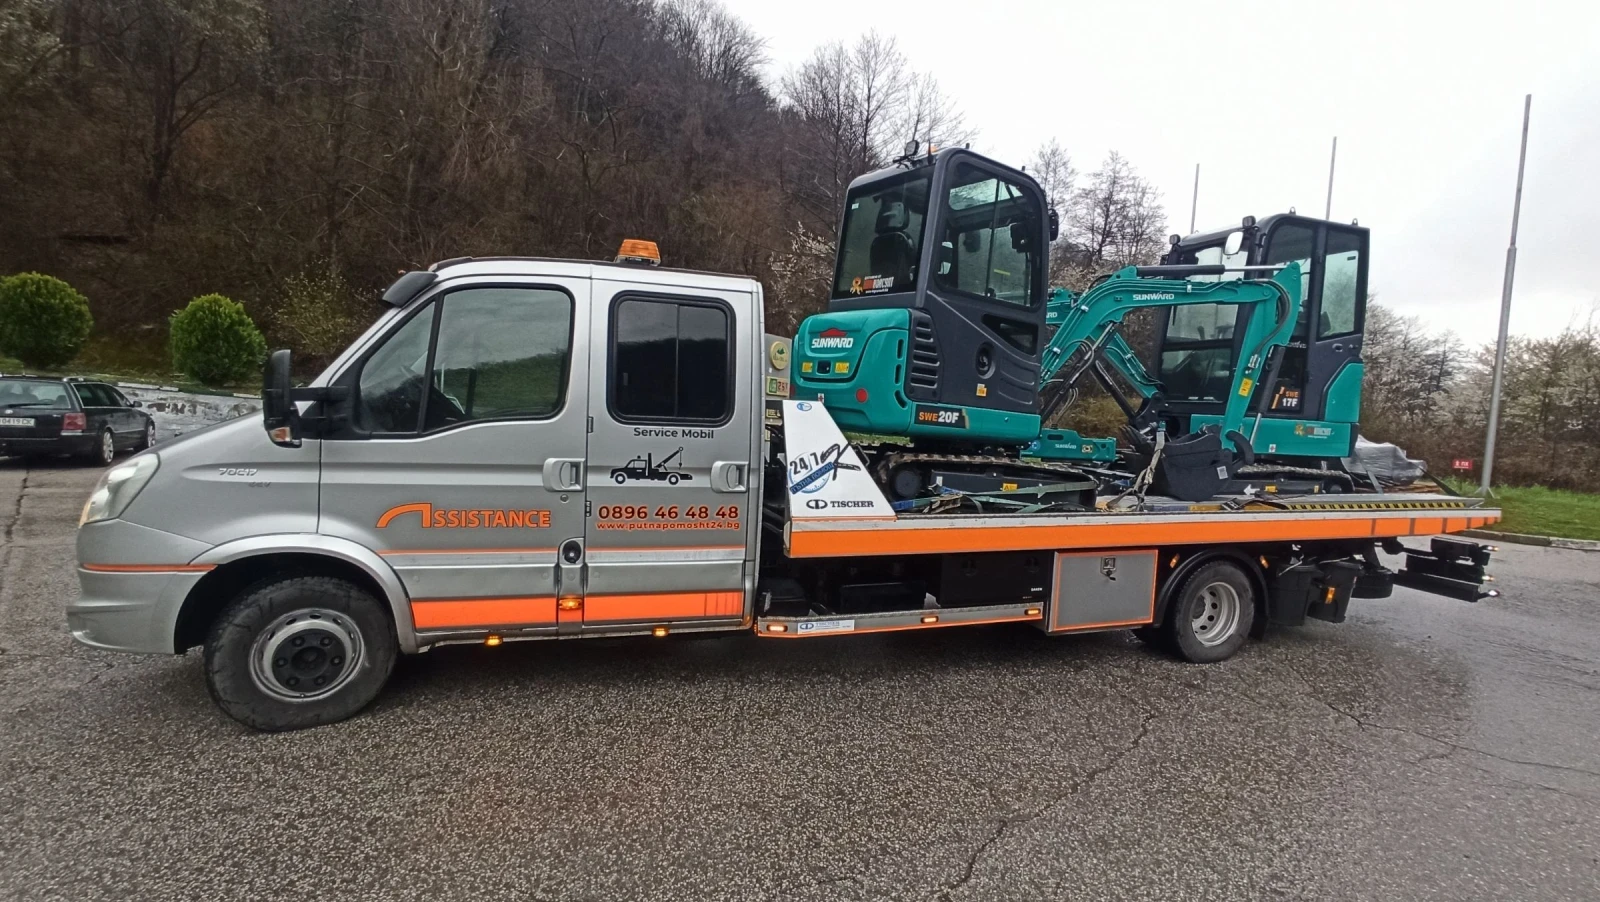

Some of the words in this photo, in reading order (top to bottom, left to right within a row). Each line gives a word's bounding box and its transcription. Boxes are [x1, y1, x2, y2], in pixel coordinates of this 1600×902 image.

[1132, 292, 1175, 300] SUNWARD
[811, 337, 854, 348] SUNWARD
[1282, 397, 1298, 407] 17F
[918, 411, 960, 424] SWE20F
[633, 427, 678, 438] Service
[682, 429, 714, 439] Mobil
[218, 467, 258, 477] 70C17
[830, 500, 874, 508] TISCHER
[598, 505, 648, 520] 0896
[654, 505, 679, 520] 46
[685, 505, 709, 520] 48
[715, 505, 739, 520] 48
[596, 521, 740, 530] www.putnapomosht24.bg
